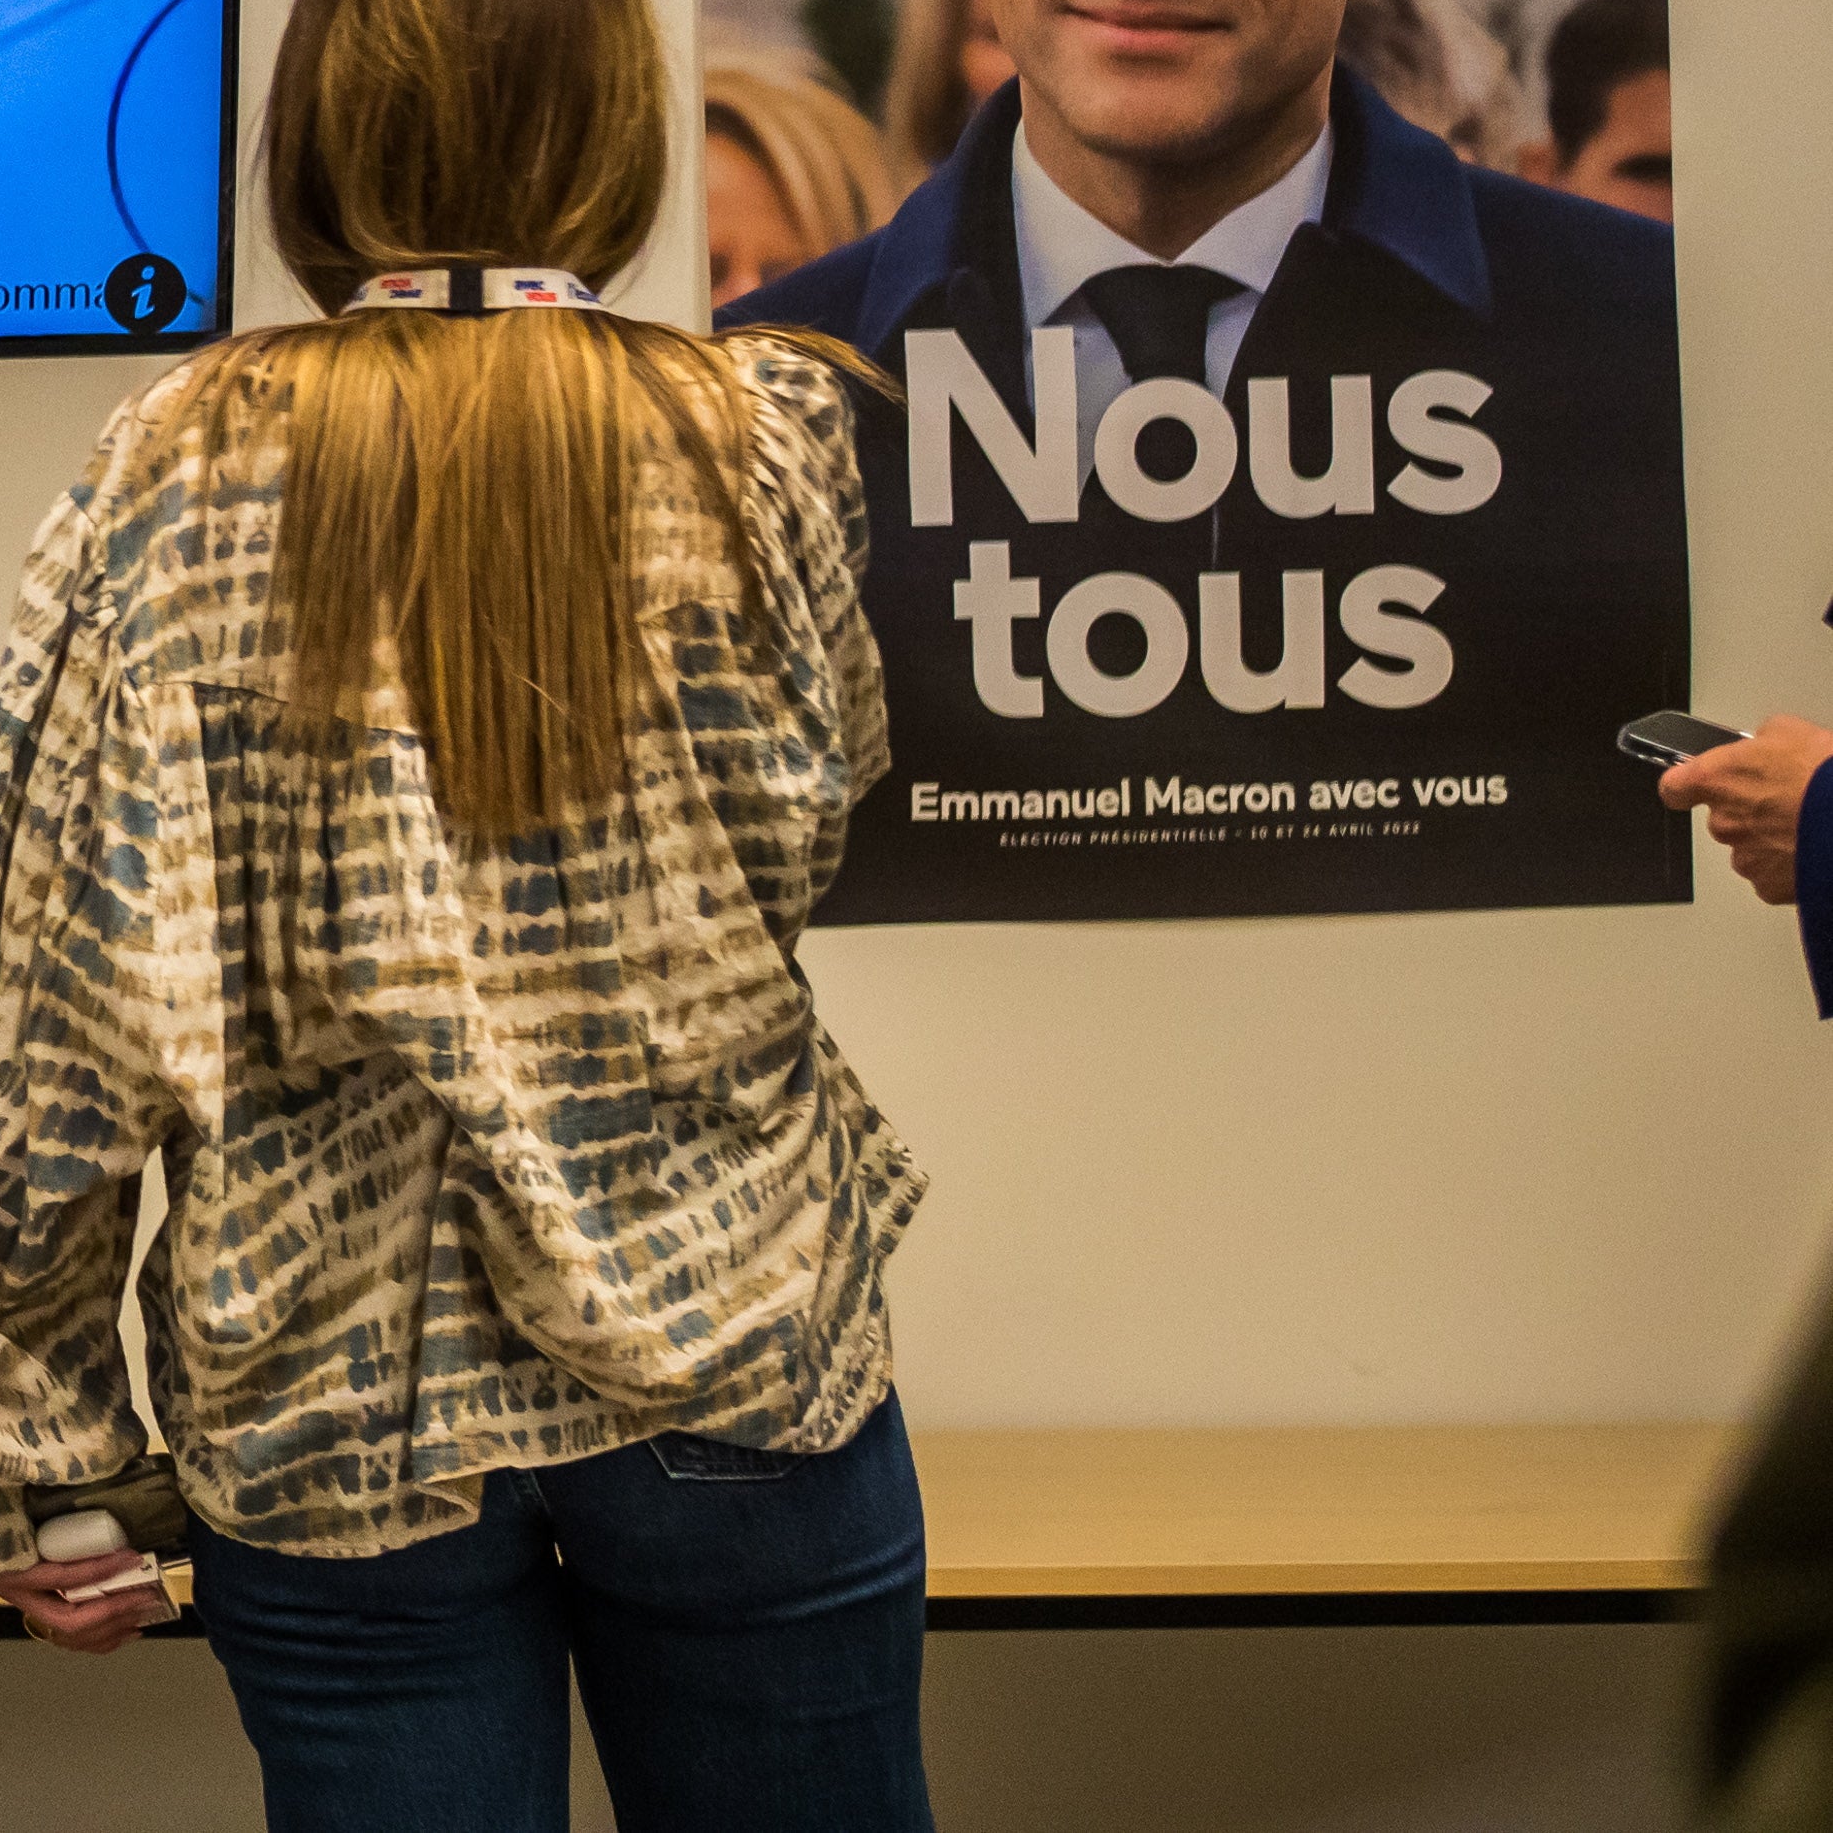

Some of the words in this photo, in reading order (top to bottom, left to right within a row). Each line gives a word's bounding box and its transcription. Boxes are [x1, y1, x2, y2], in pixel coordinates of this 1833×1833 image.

[903, 325, 1503, 528] Nous
[953, 539, 1455, 719] tous
[910, 776, 1131, 822] Emmanuel
[1144, 774, 1297, 816] Macron
[1308, 777, 1401, 811] avec
[1412, 773, 1509, 808] vous
